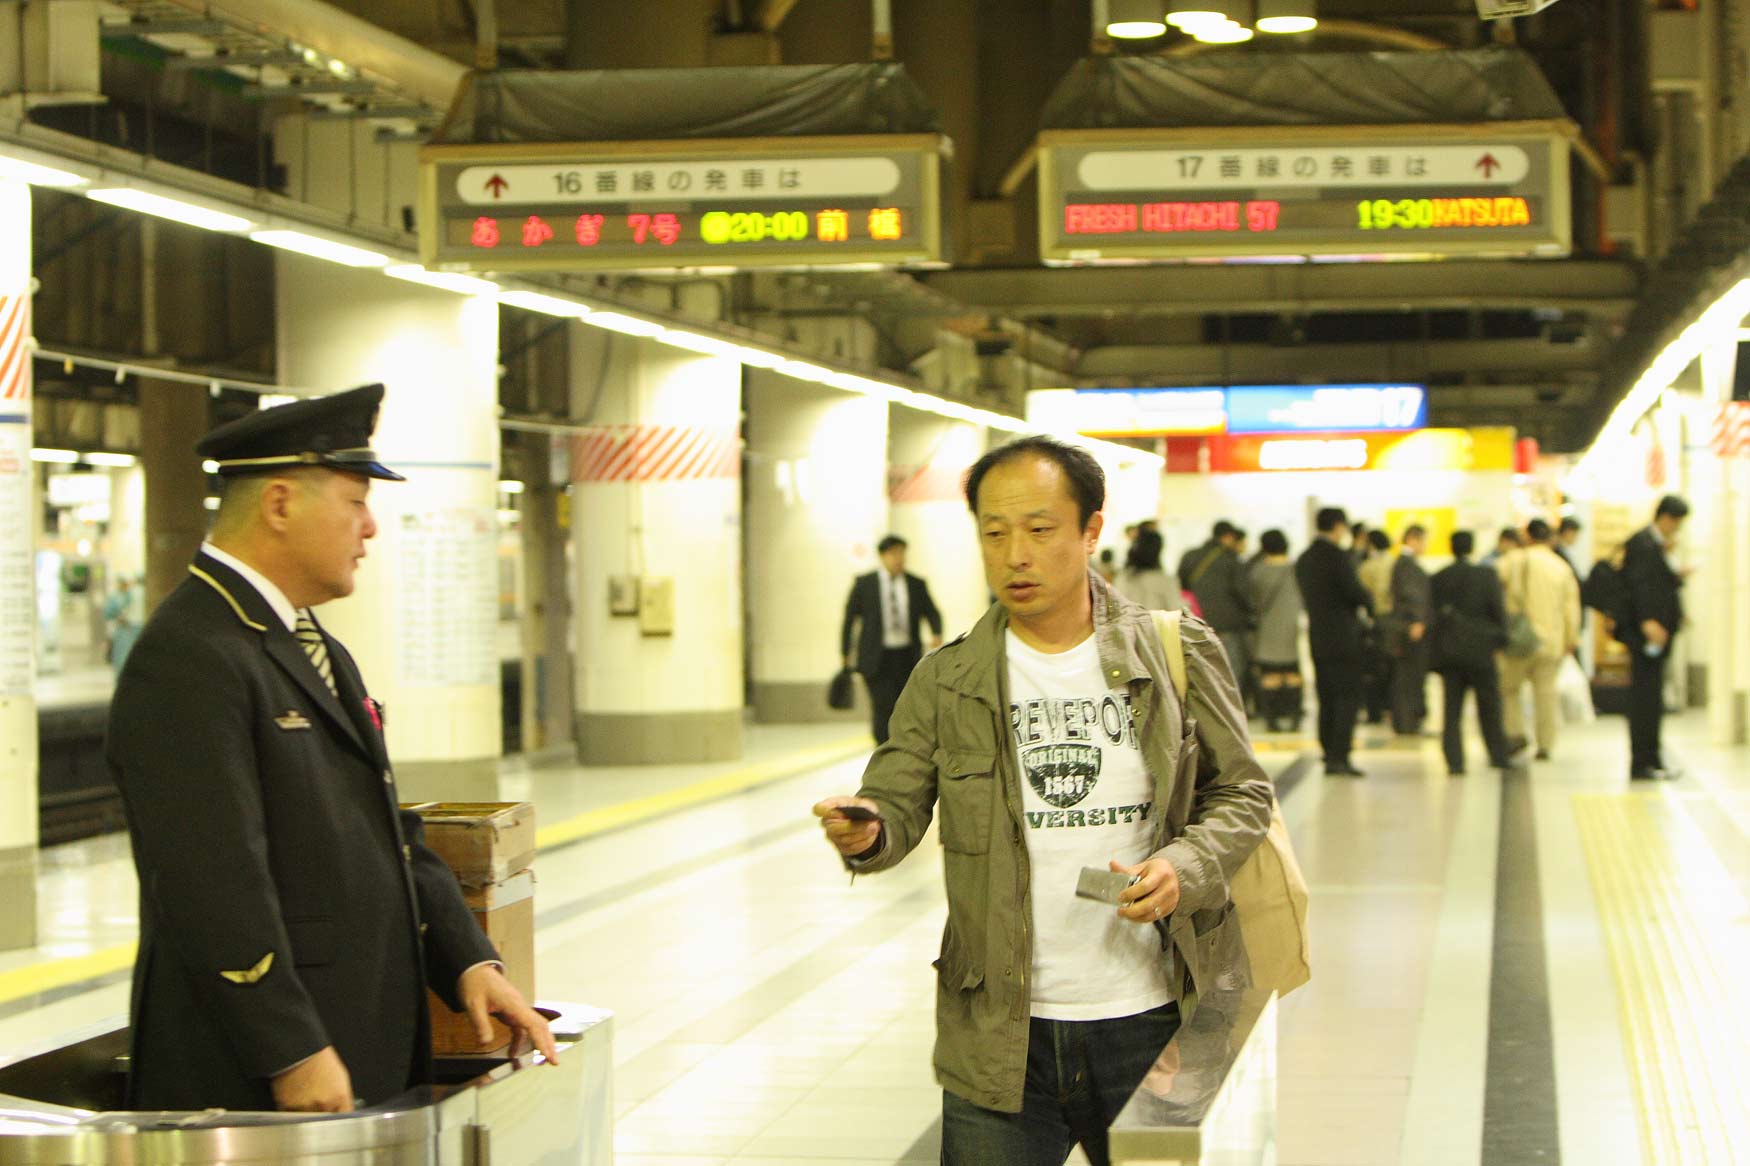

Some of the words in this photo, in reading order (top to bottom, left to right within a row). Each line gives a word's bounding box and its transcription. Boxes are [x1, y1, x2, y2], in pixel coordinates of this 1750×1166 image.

[1065, 203, 1137, 233] FRESH
[1142, 202, 1240, 232] HITACHI
[1246, 201, 1280, 231] 57
[1358, 199, 1432, 229] 19:30
[1432, 197, 1530, 227] KATSUTA
[1025, 801, 1152, 829] VERSITY
